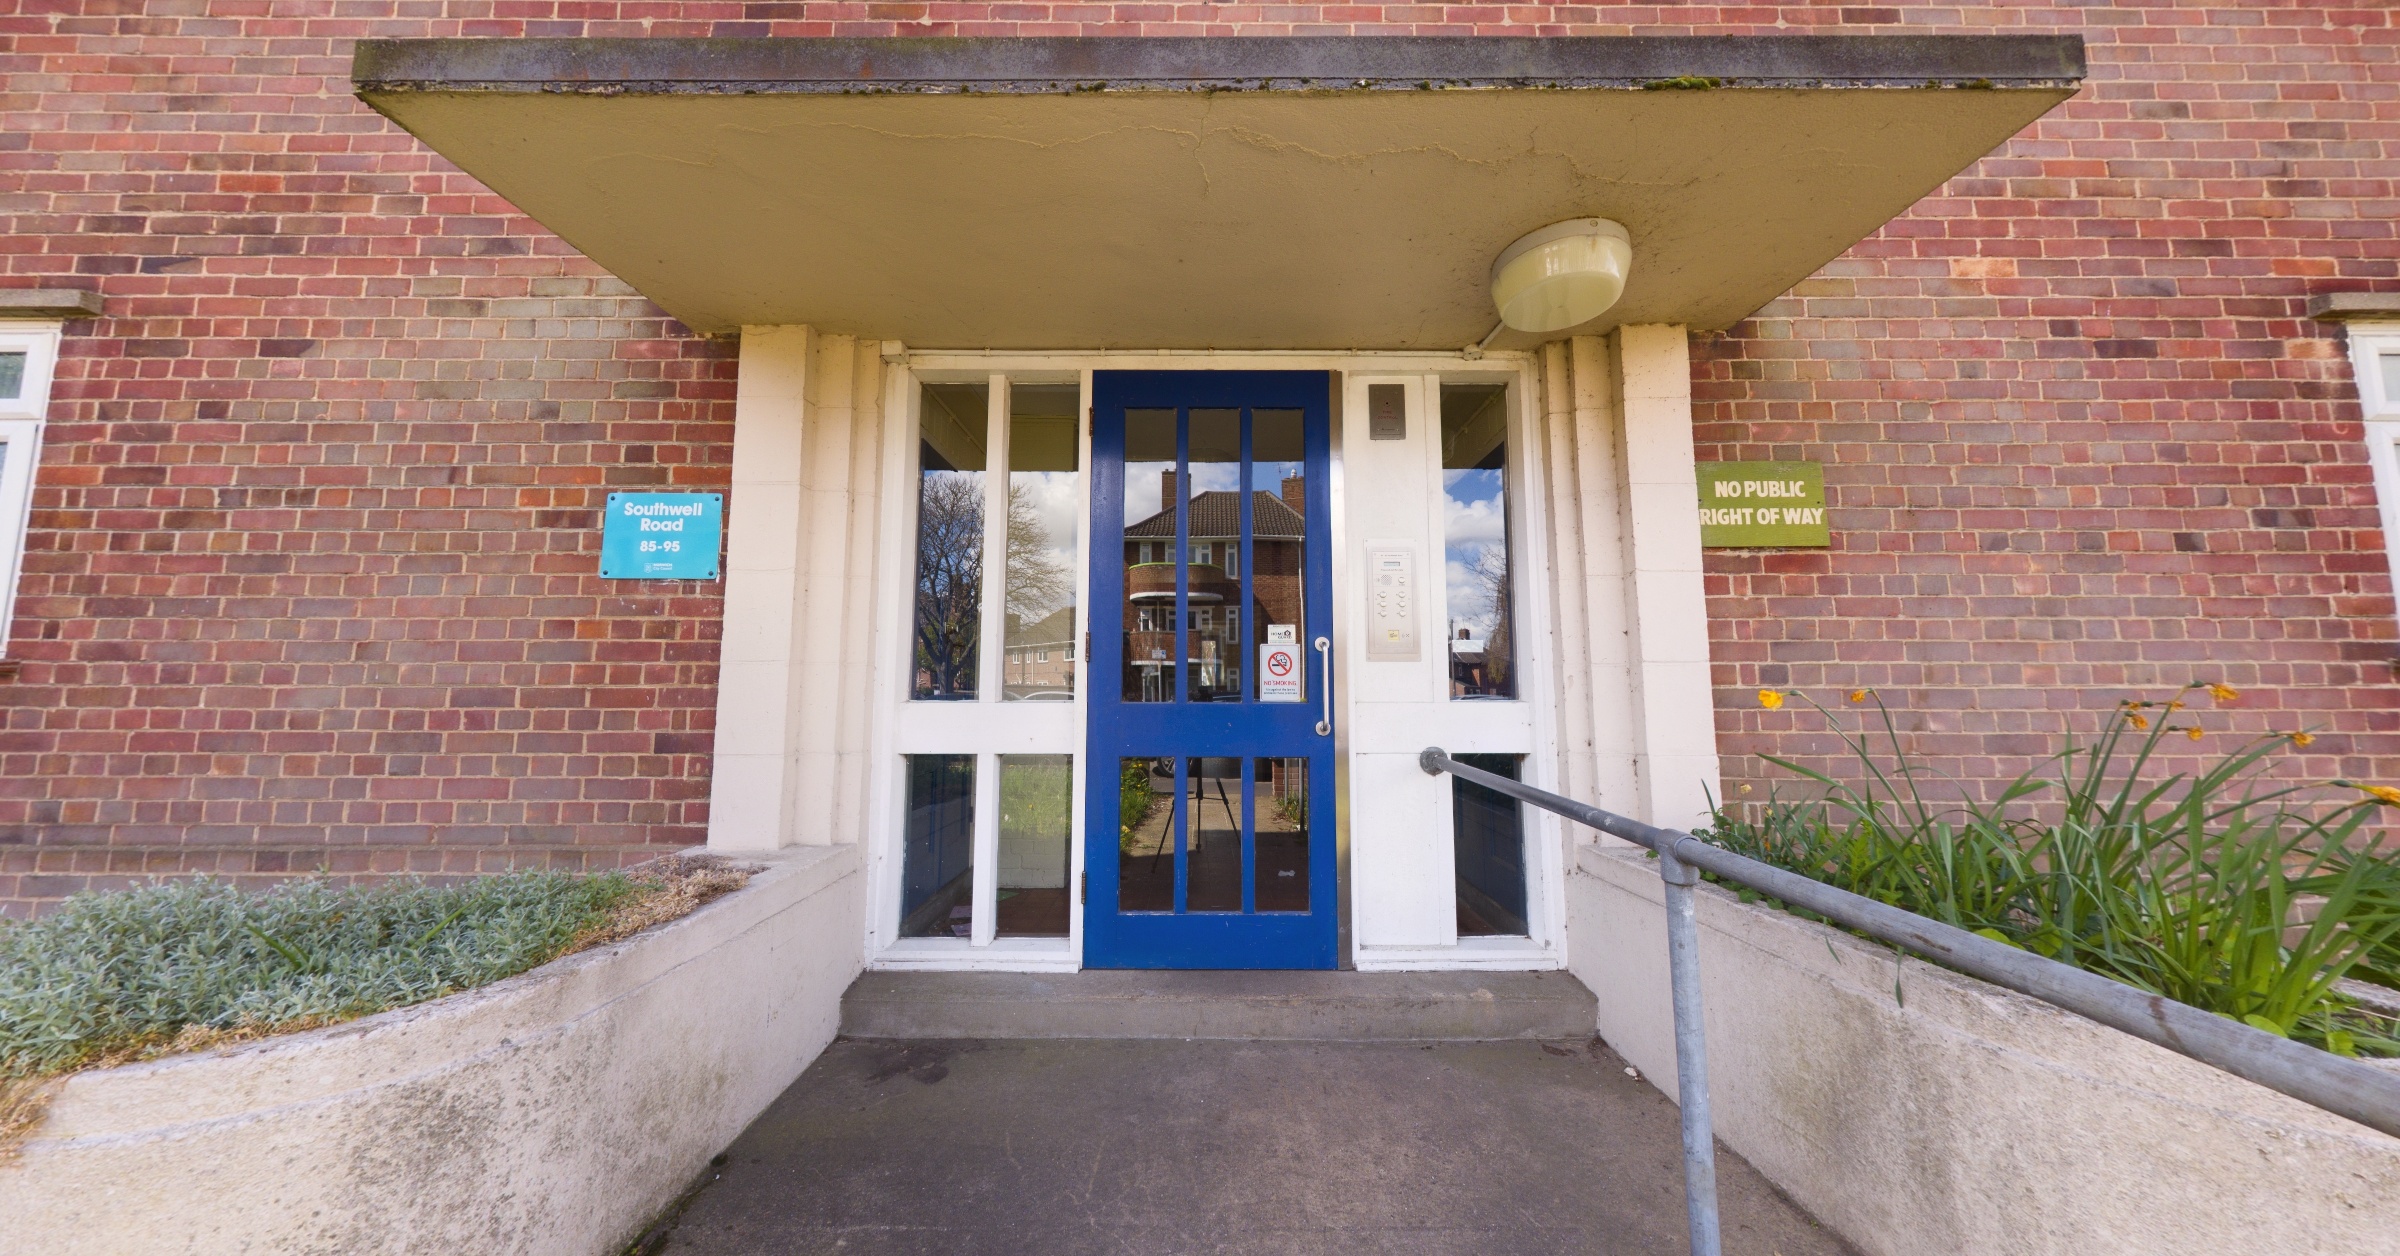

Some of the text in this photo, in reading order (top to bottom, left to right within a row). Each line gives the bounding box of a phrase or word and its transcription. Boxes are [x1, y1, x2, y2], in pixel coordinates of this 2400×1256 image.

[1715, 480, 1806, 498] NO PUBLIC
[624, 502, 703, 516] Southwell
[1700, 508, 1823, 525] RIGHT OF WAY
[640, 518, 684, 532] Road
[640, 540, 680, 552] 85-95
